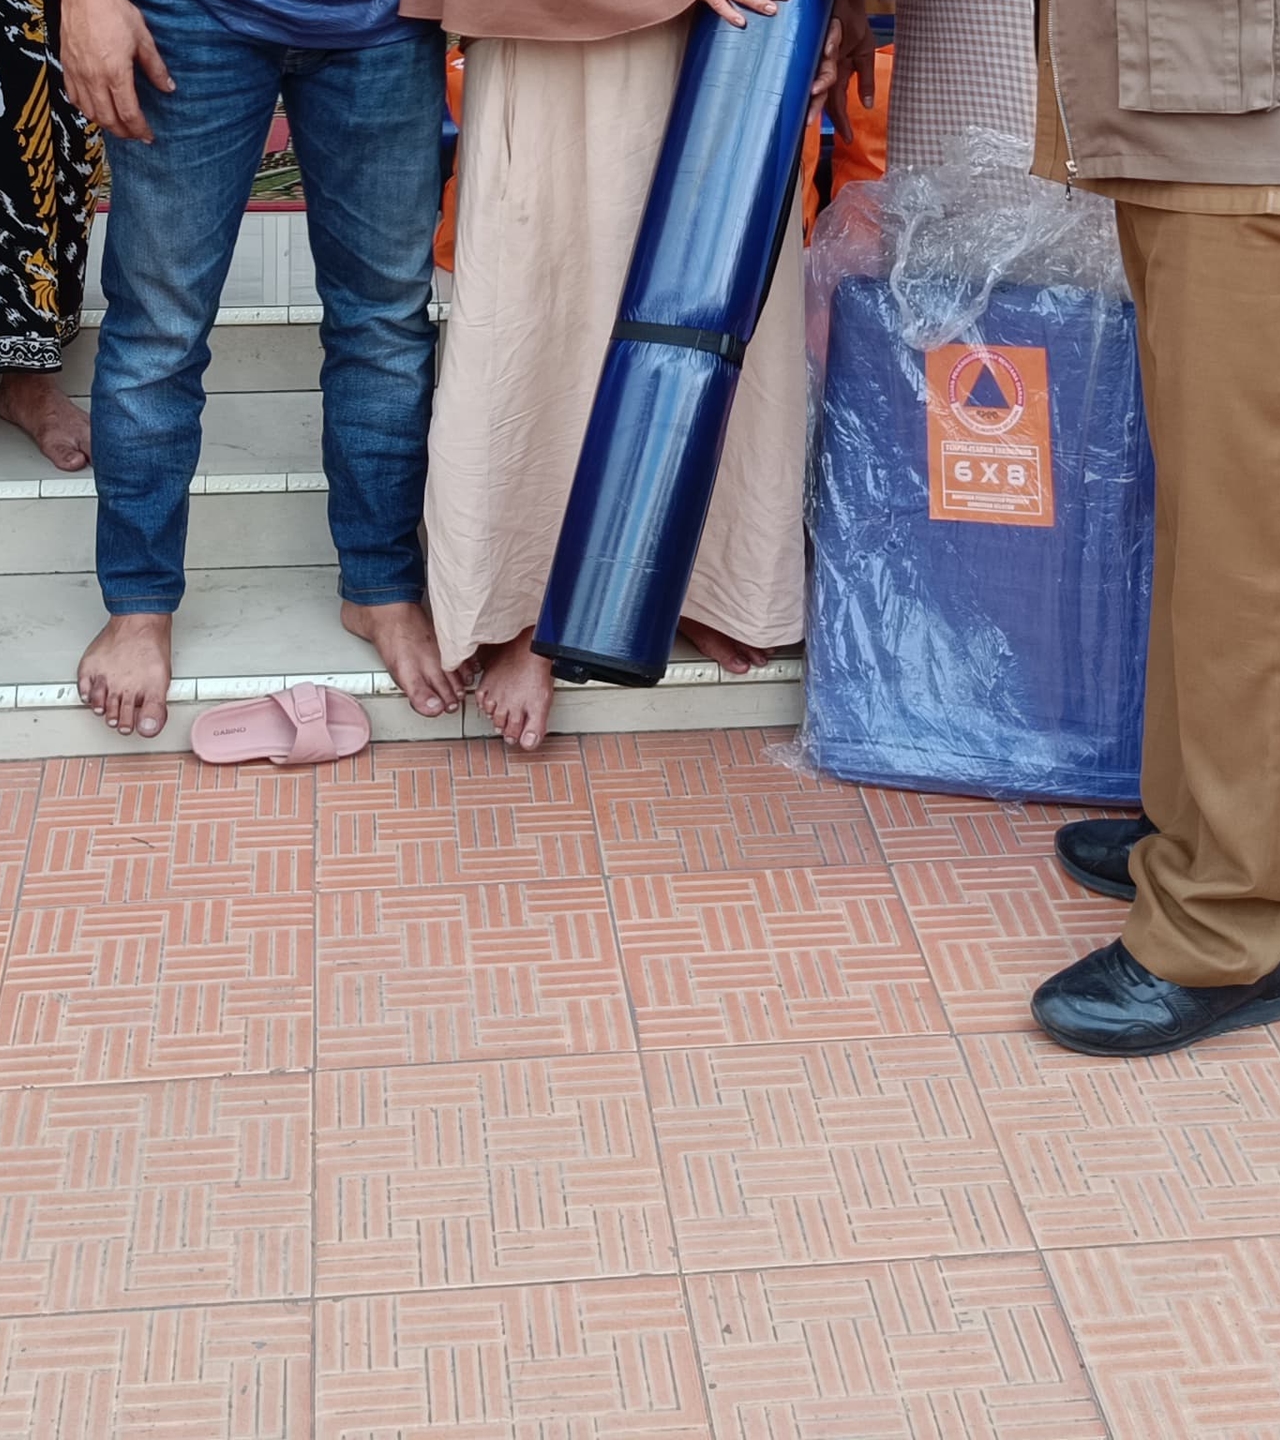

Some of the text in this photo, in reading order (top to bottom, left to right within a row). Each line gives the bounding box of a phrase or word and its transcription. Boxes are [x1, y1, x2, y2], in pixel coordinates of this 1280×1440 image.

[954, 460, 1026, 488] 6 X 8
[213, 726, 247, 737] GABINO
